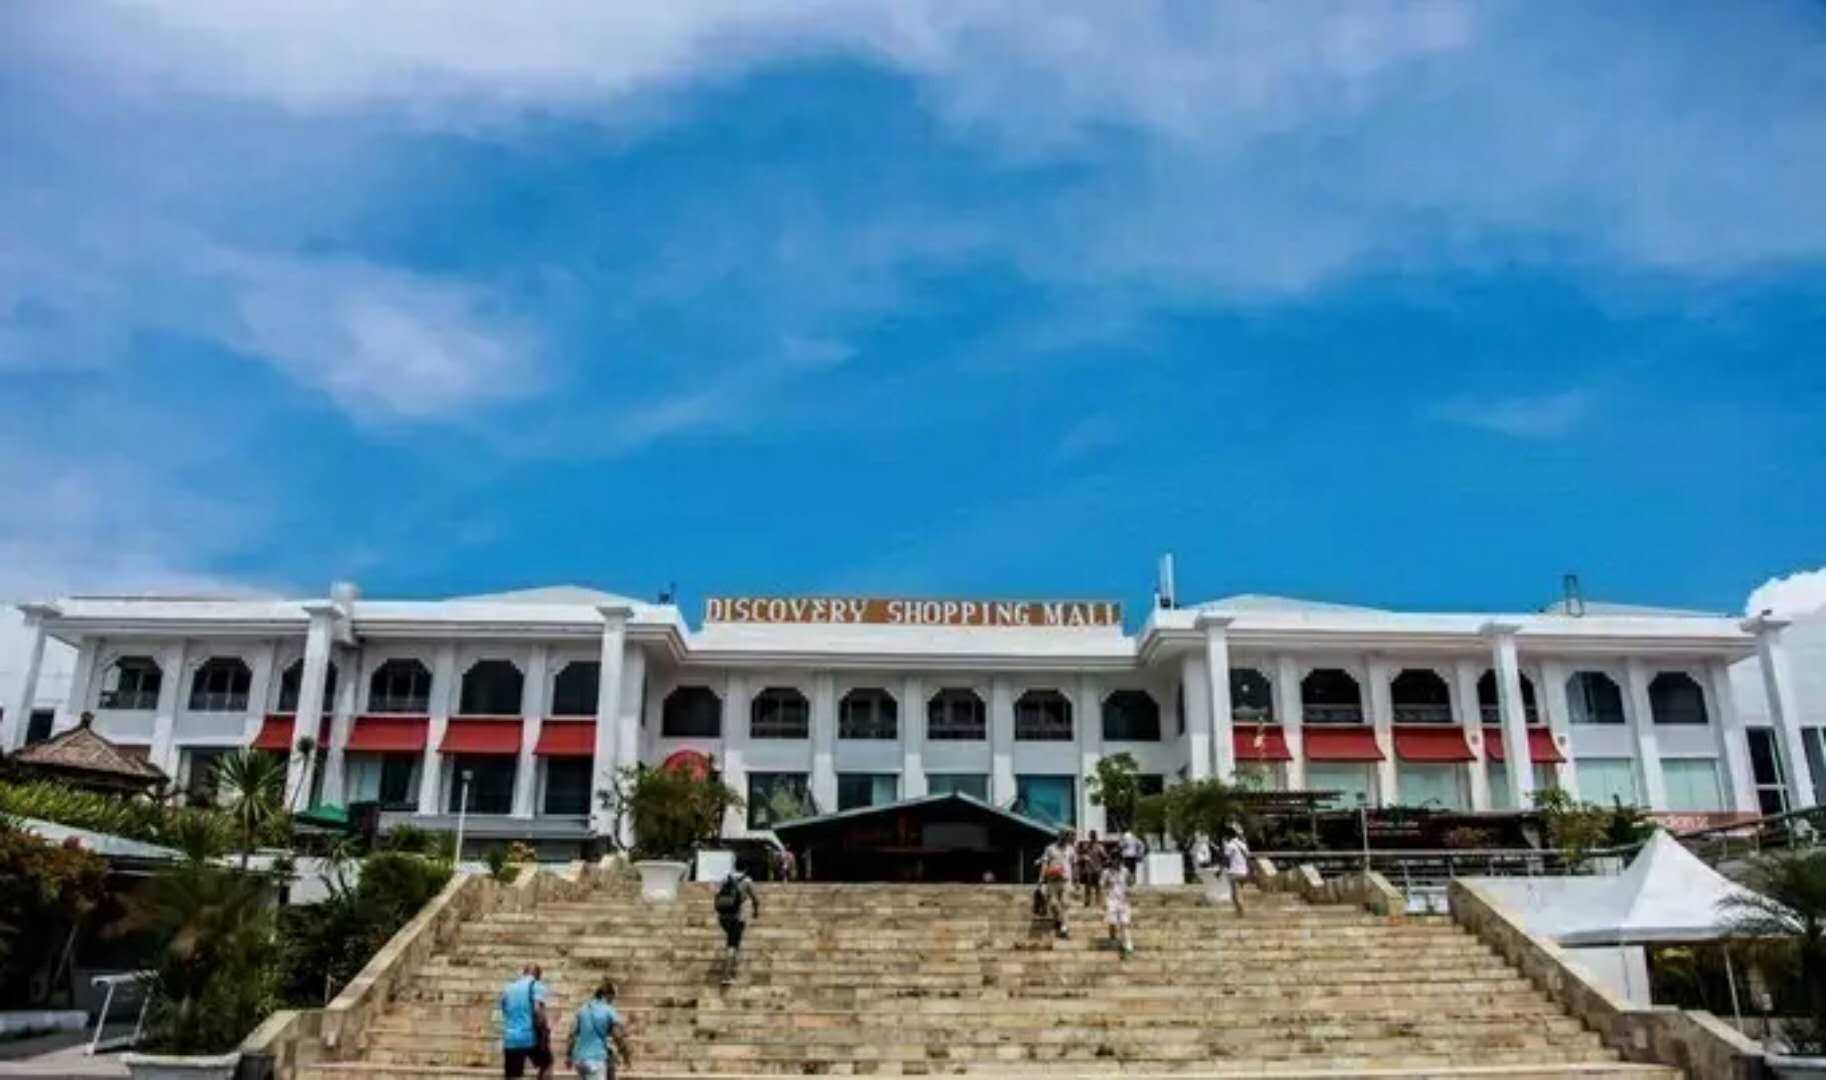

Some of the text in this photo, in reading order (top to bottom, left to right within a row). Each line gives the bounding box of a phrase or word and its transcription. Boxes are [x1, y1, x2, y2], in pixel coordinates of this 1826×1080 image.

[706, 598, 1121, 625] DISCOVERY SHOPPING MALL
